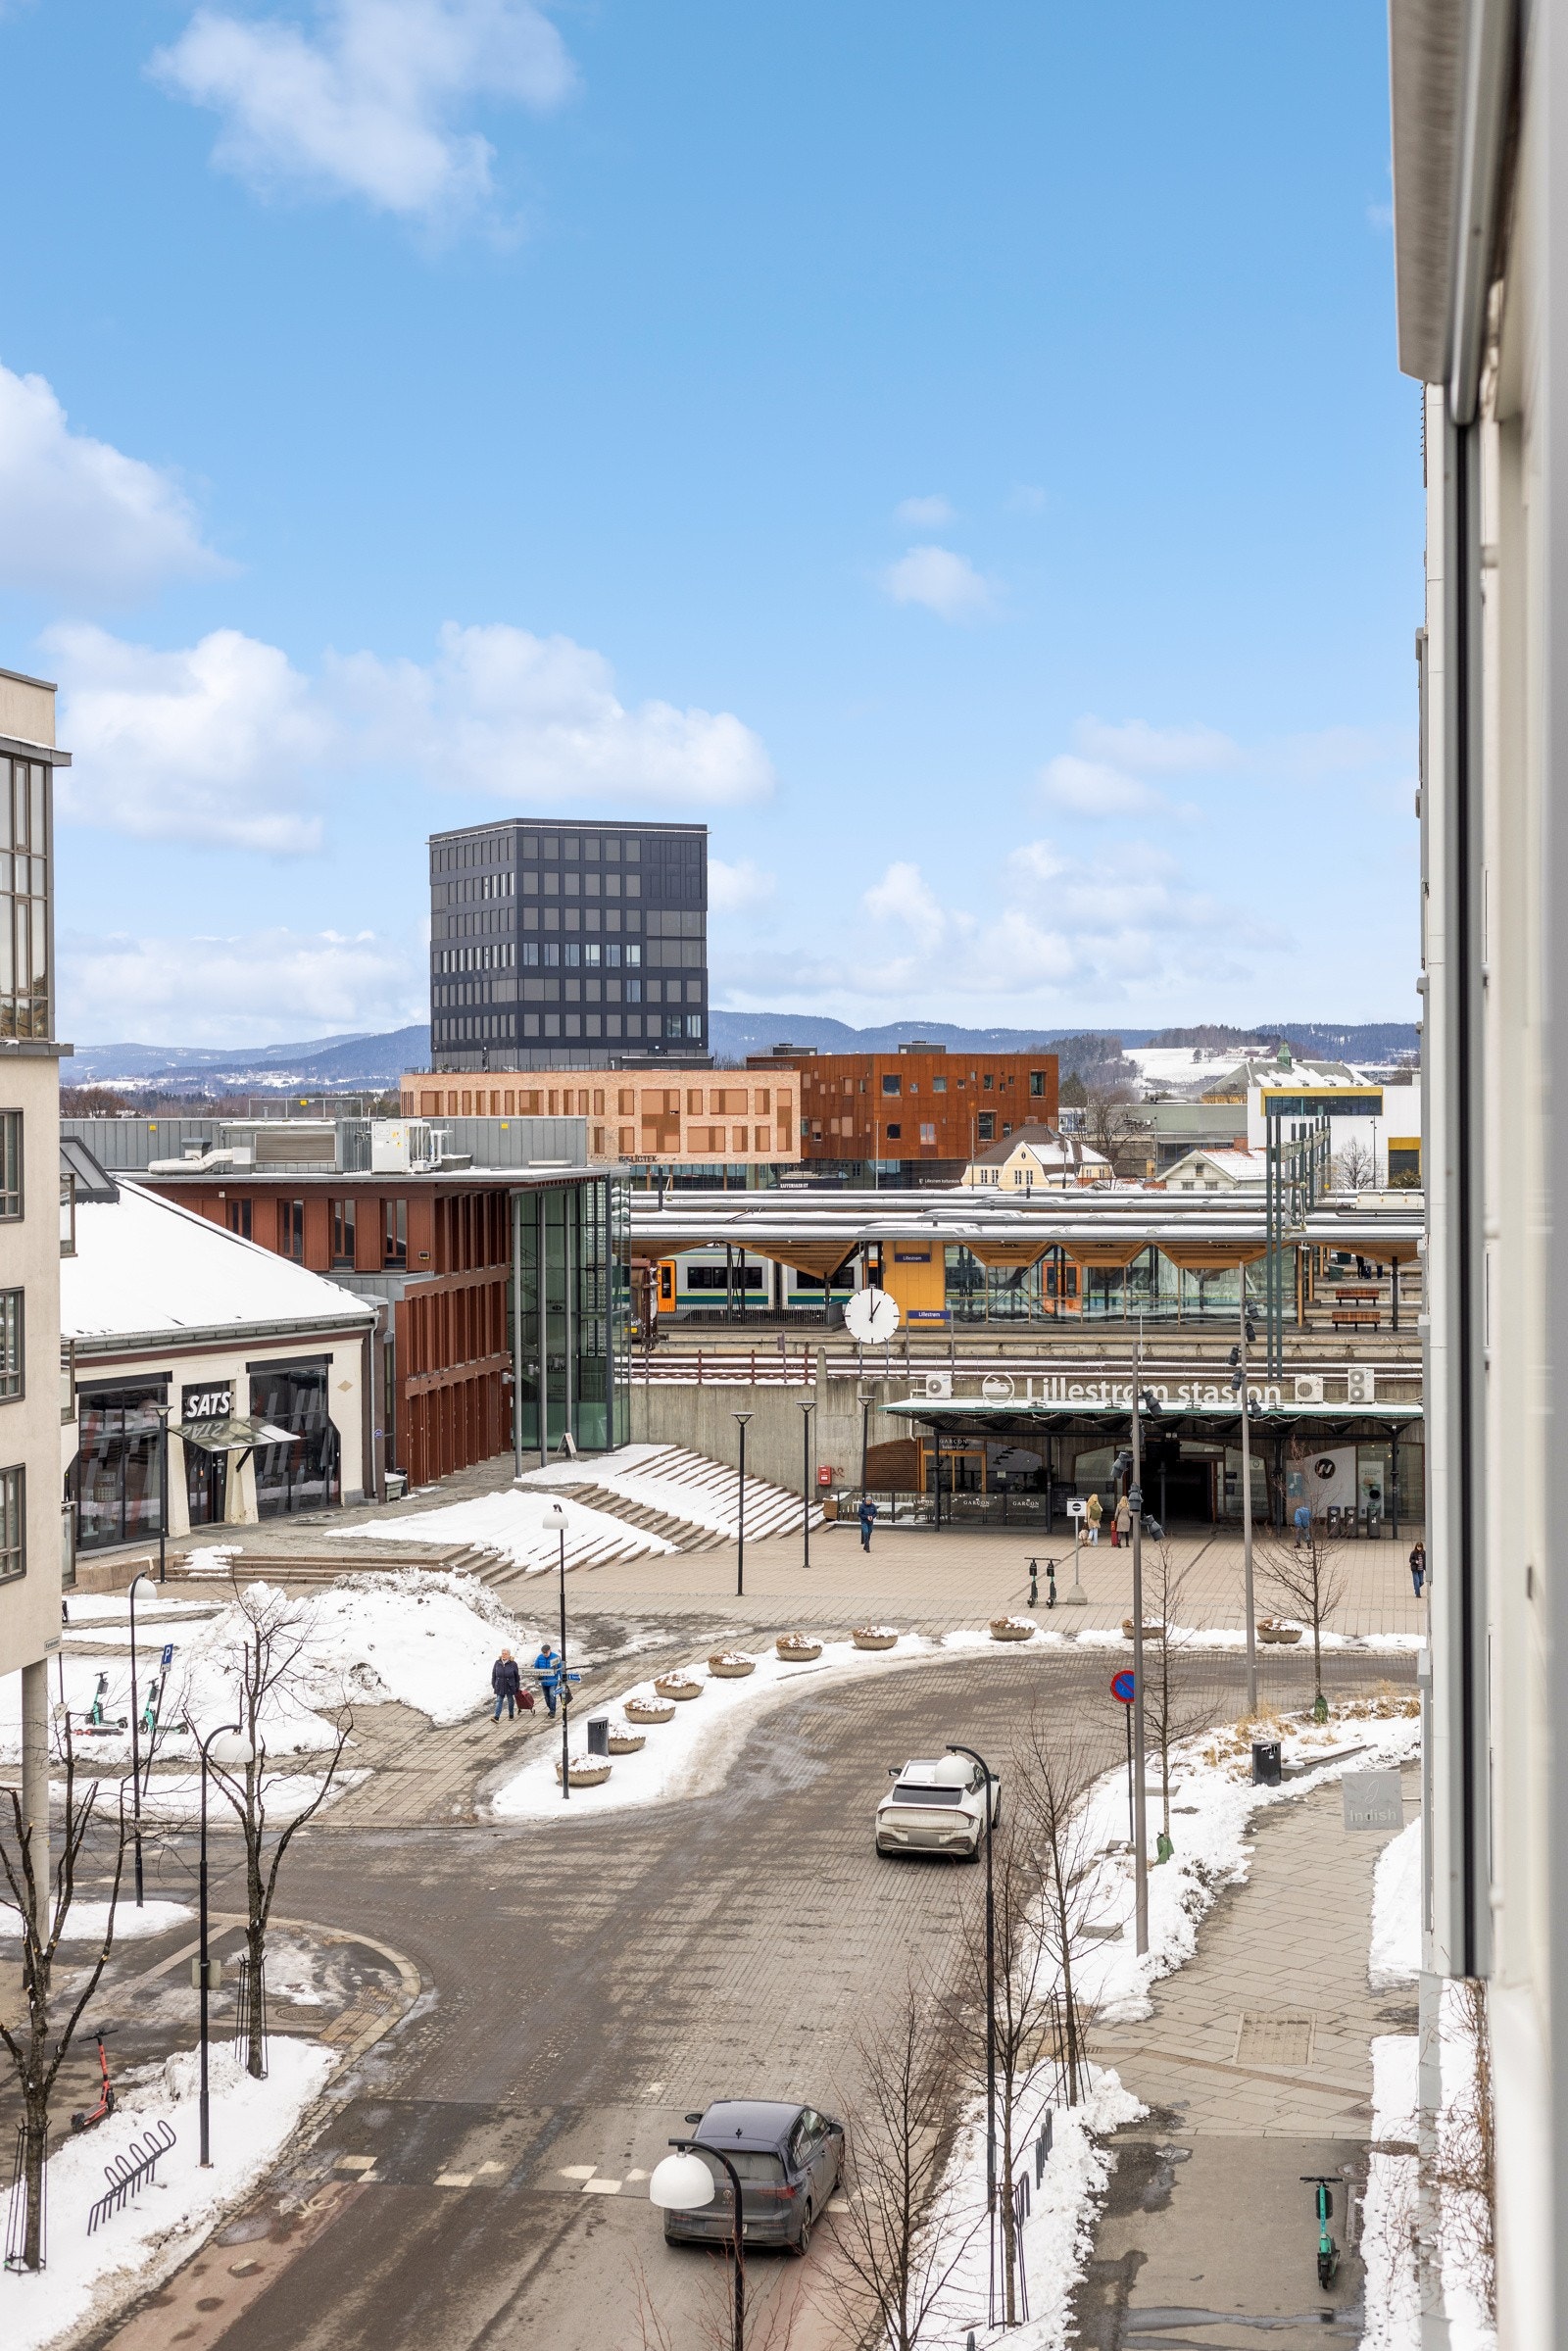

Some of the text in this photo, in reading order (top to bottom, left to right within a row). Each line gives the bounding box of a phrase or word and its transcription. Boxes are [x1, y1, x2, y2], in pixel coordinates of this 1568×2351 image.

[185, 1391, 232, 1418] SATS
[164, 1646, 172, 1663] P
[1349, 1808, 1397, 1822] Indish
